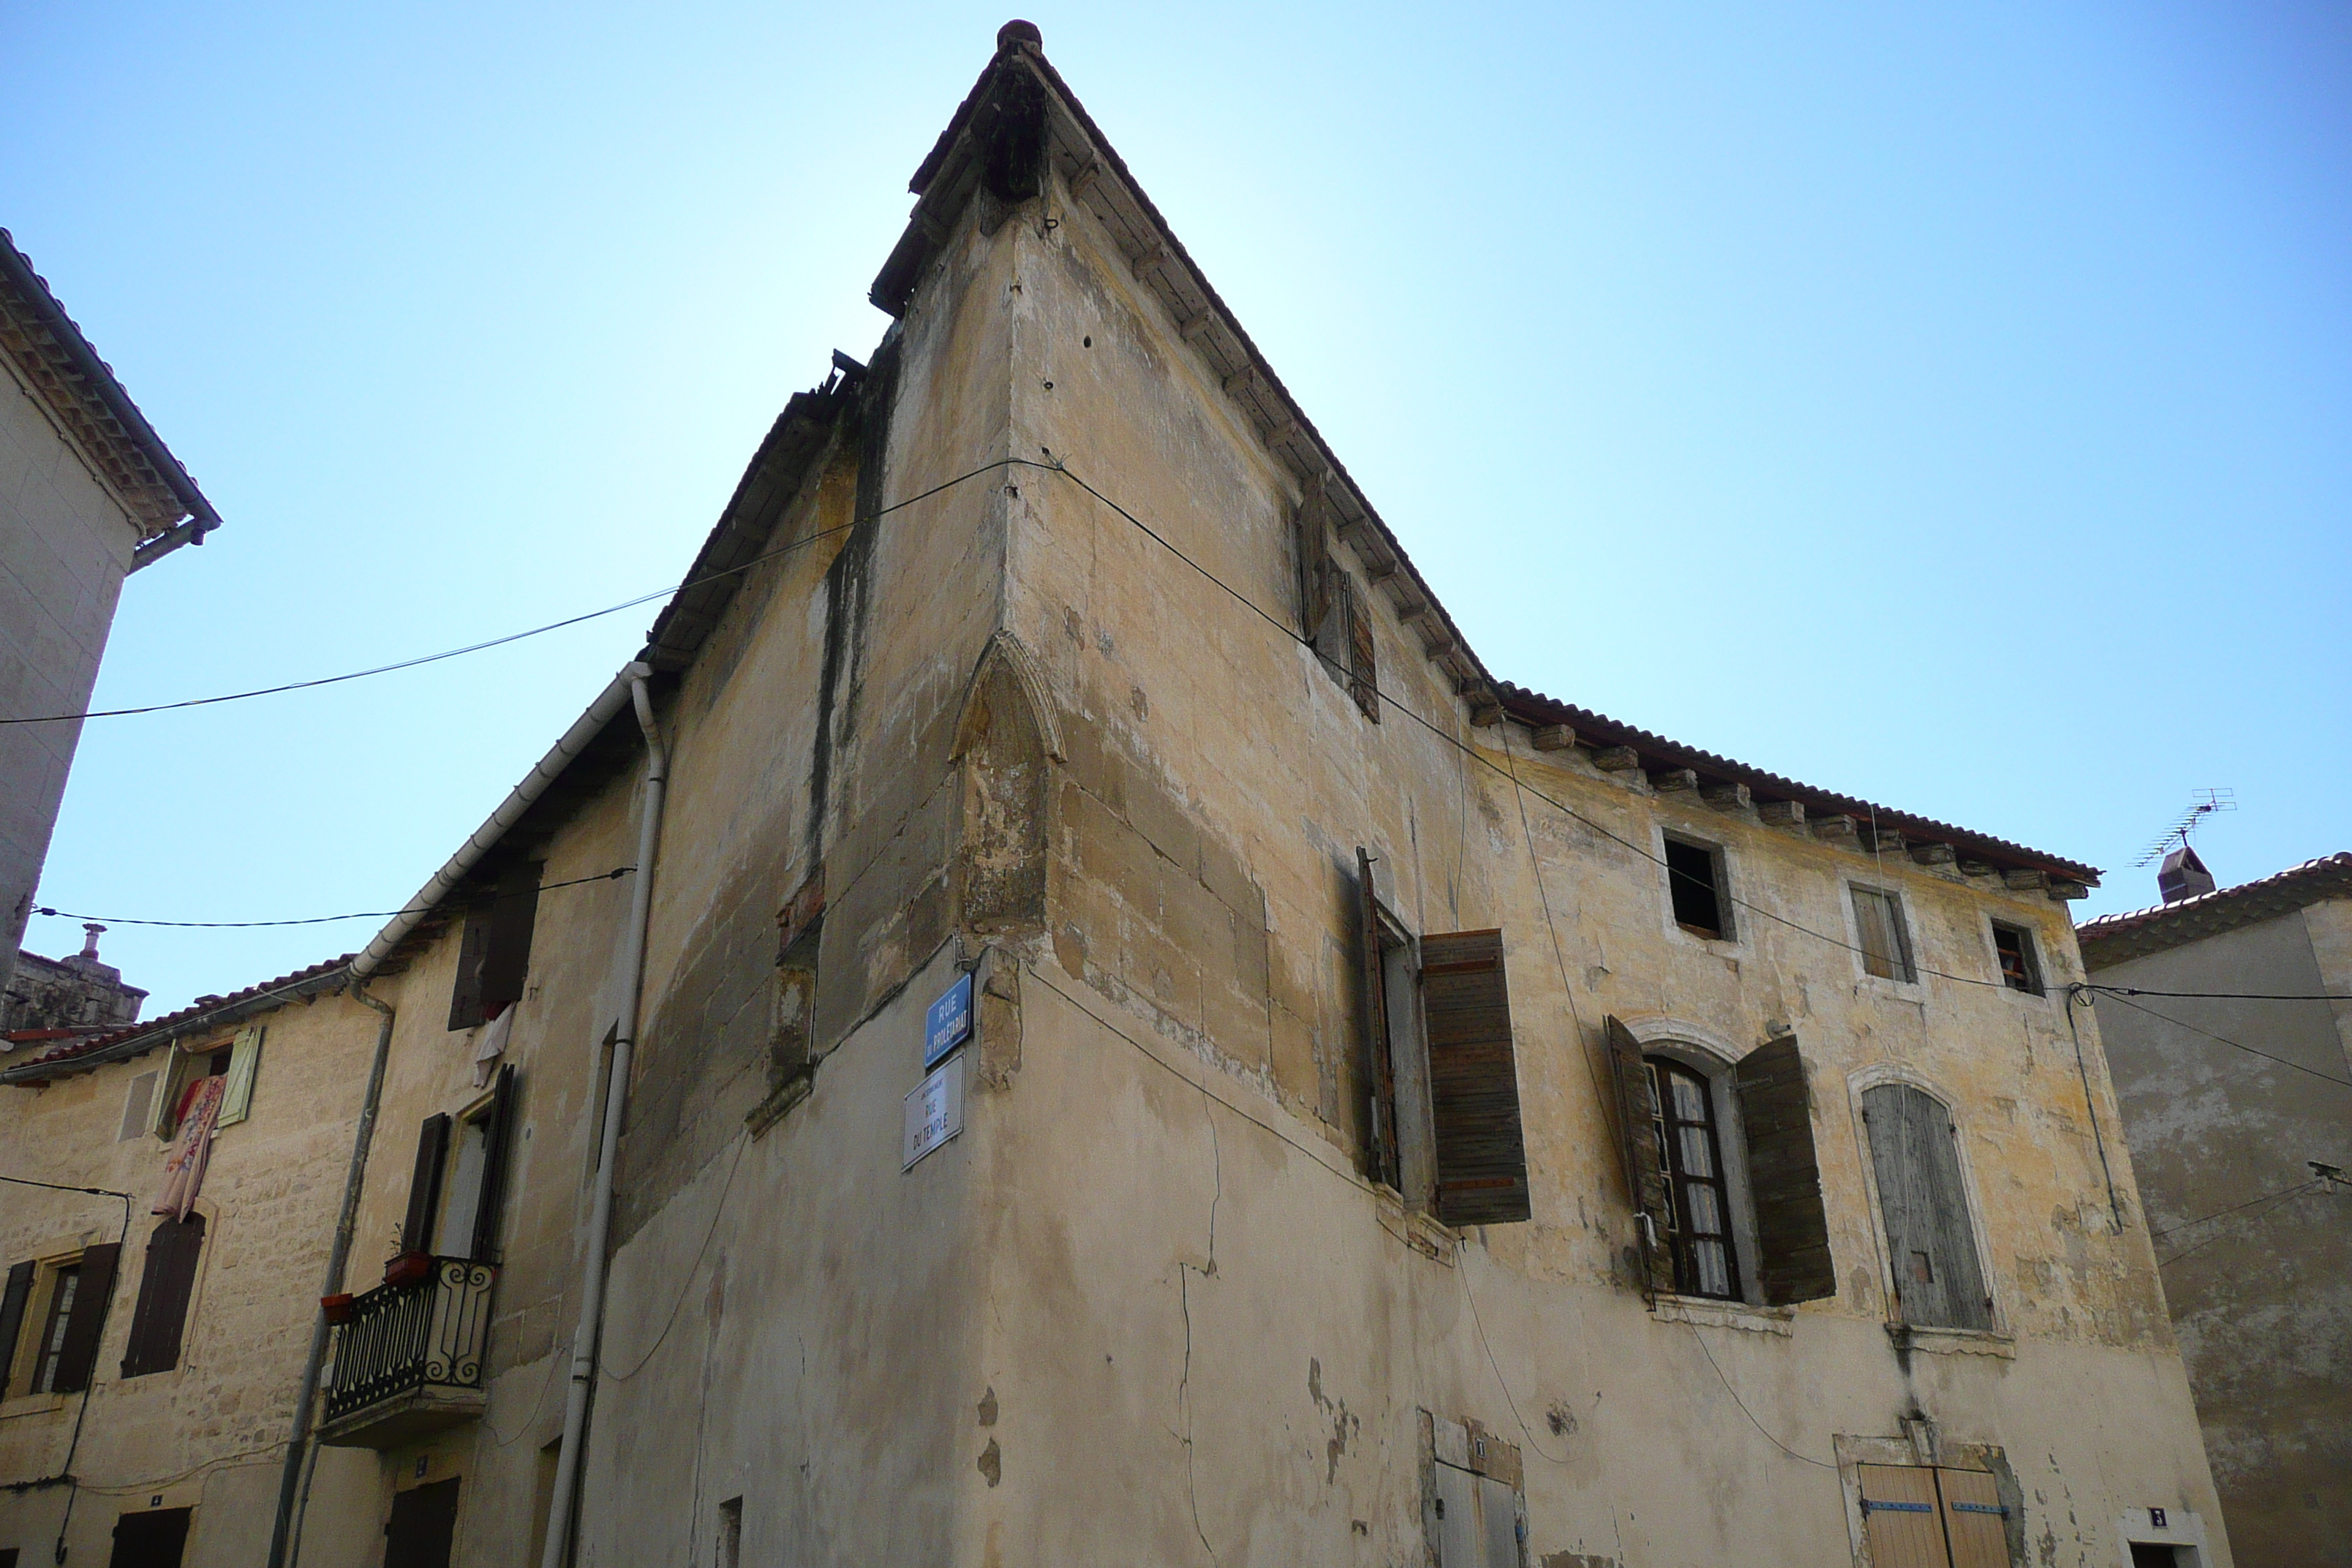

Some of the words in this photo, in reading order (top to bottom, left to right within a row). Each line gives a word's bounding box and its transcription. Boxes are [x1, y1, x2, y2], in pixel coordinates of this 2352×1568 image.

[938, 994, 957, 1023] RUE
[933, 1009, 967, 1052] PROLÉTARIAT
[925, 1098, 937, 1118] RUE
[913, 1131, 922, 1150] DU
[924, 1112, 948, 1143] TEMPLE
[2155, 1510, 2163, 1526] 3
